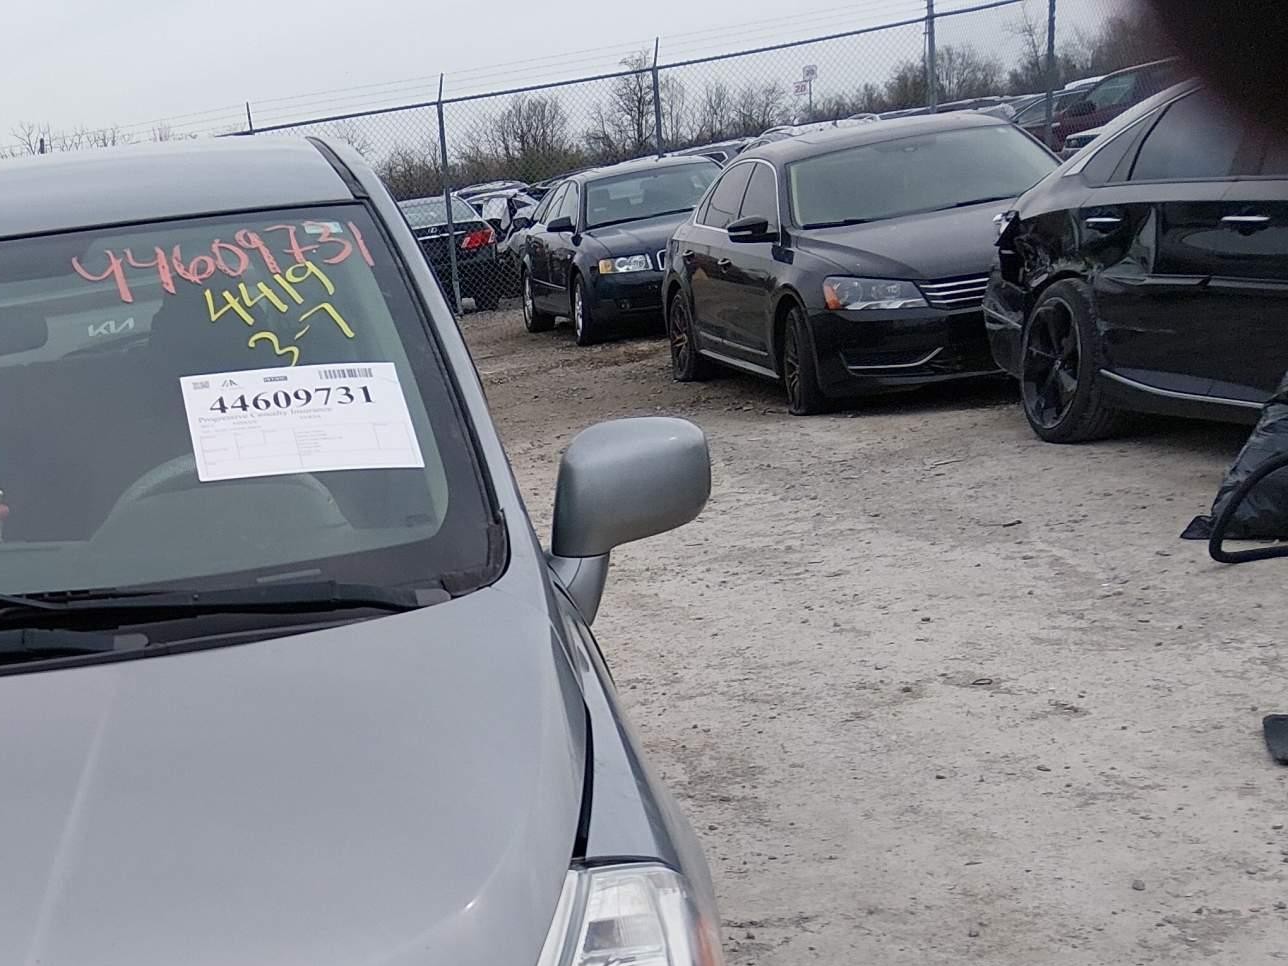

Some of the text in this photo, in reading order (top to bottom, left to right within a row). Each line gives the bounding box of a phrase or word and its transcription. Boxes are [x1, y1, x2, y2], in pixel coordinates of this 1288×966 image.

[71, 220, 375, 303] 44609731
[204, 261, 336, 326] 4419
[209, 384, 375, 414] 44609731
